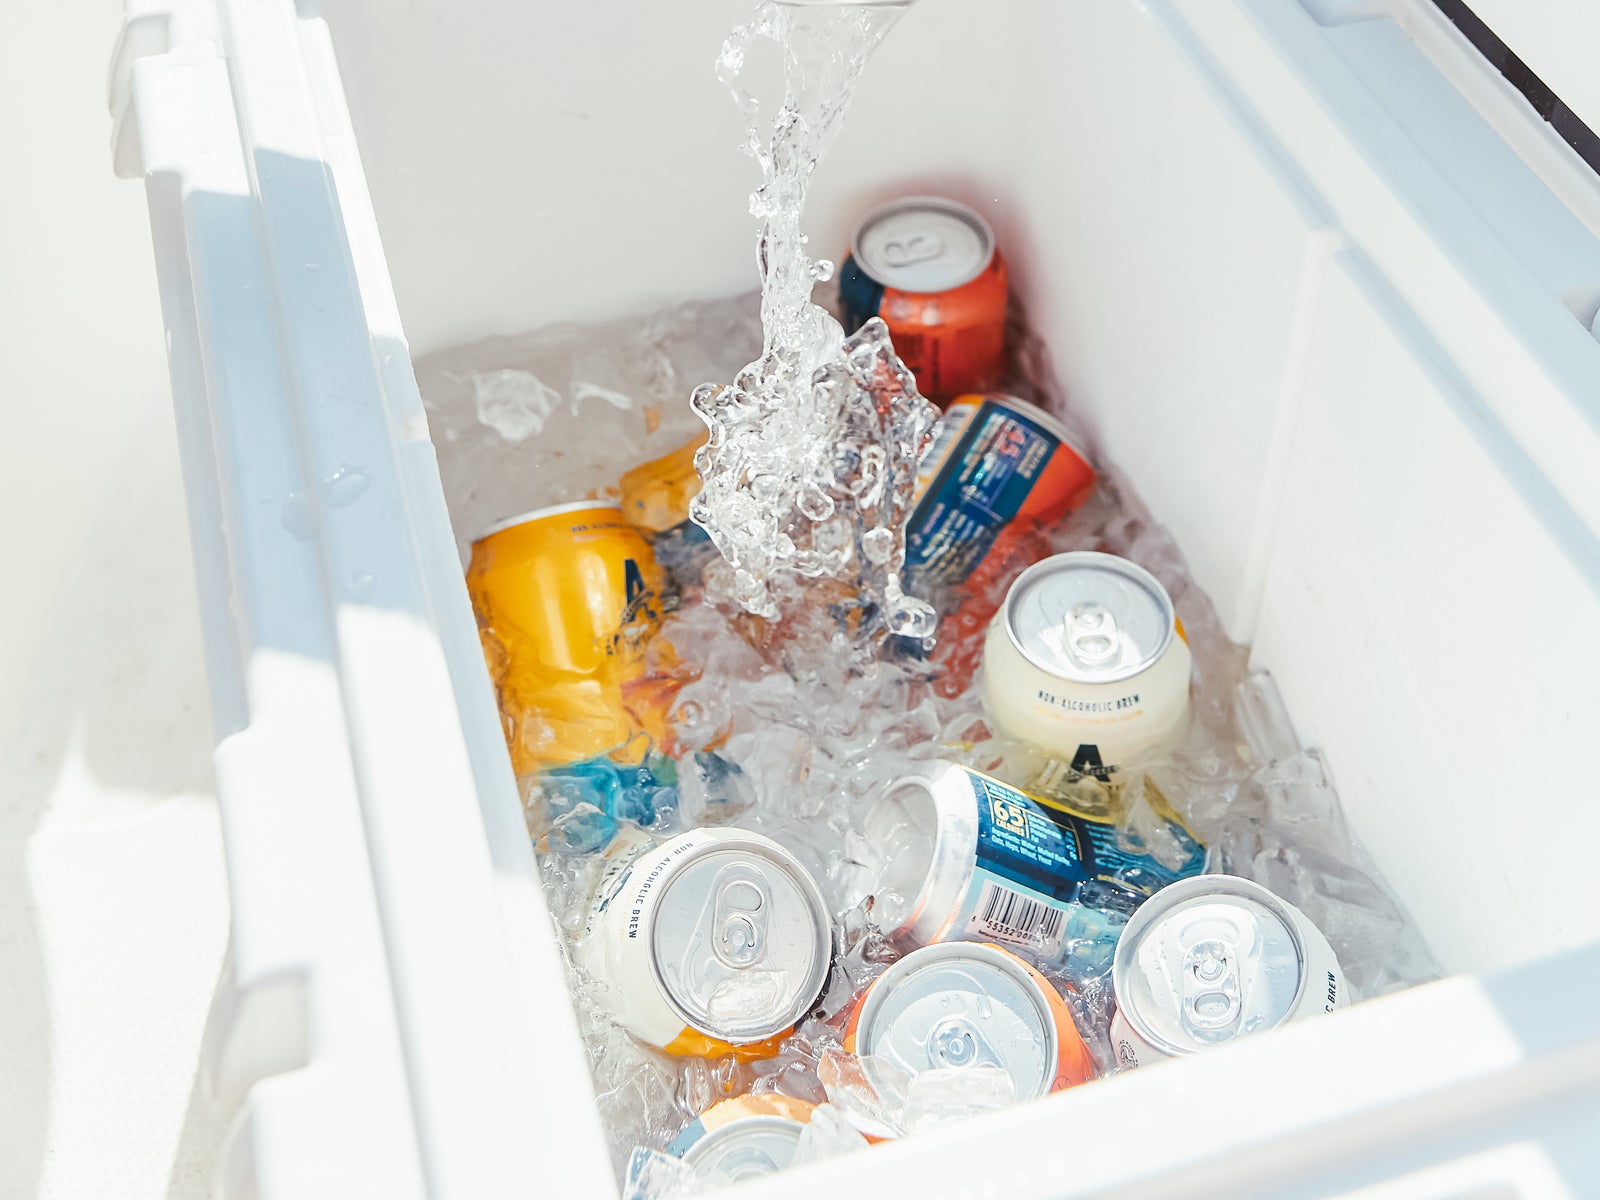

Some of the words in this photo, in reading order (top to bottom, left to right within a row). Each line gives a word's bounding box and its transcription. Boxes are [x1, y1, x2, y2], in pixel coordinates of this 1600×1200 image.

[1038, 689, 1113, 712] NON-ALCOHOLIC
[1116, 693, 1140, 710] BREW
[1067, 744, 1113, 784] A
[994, 800, 1025, 828] 65
[629, 909, 641, 939] BREW
[986, 920, 1016, 936] 55352
[1327, 970, 1336, 1004] BREW
